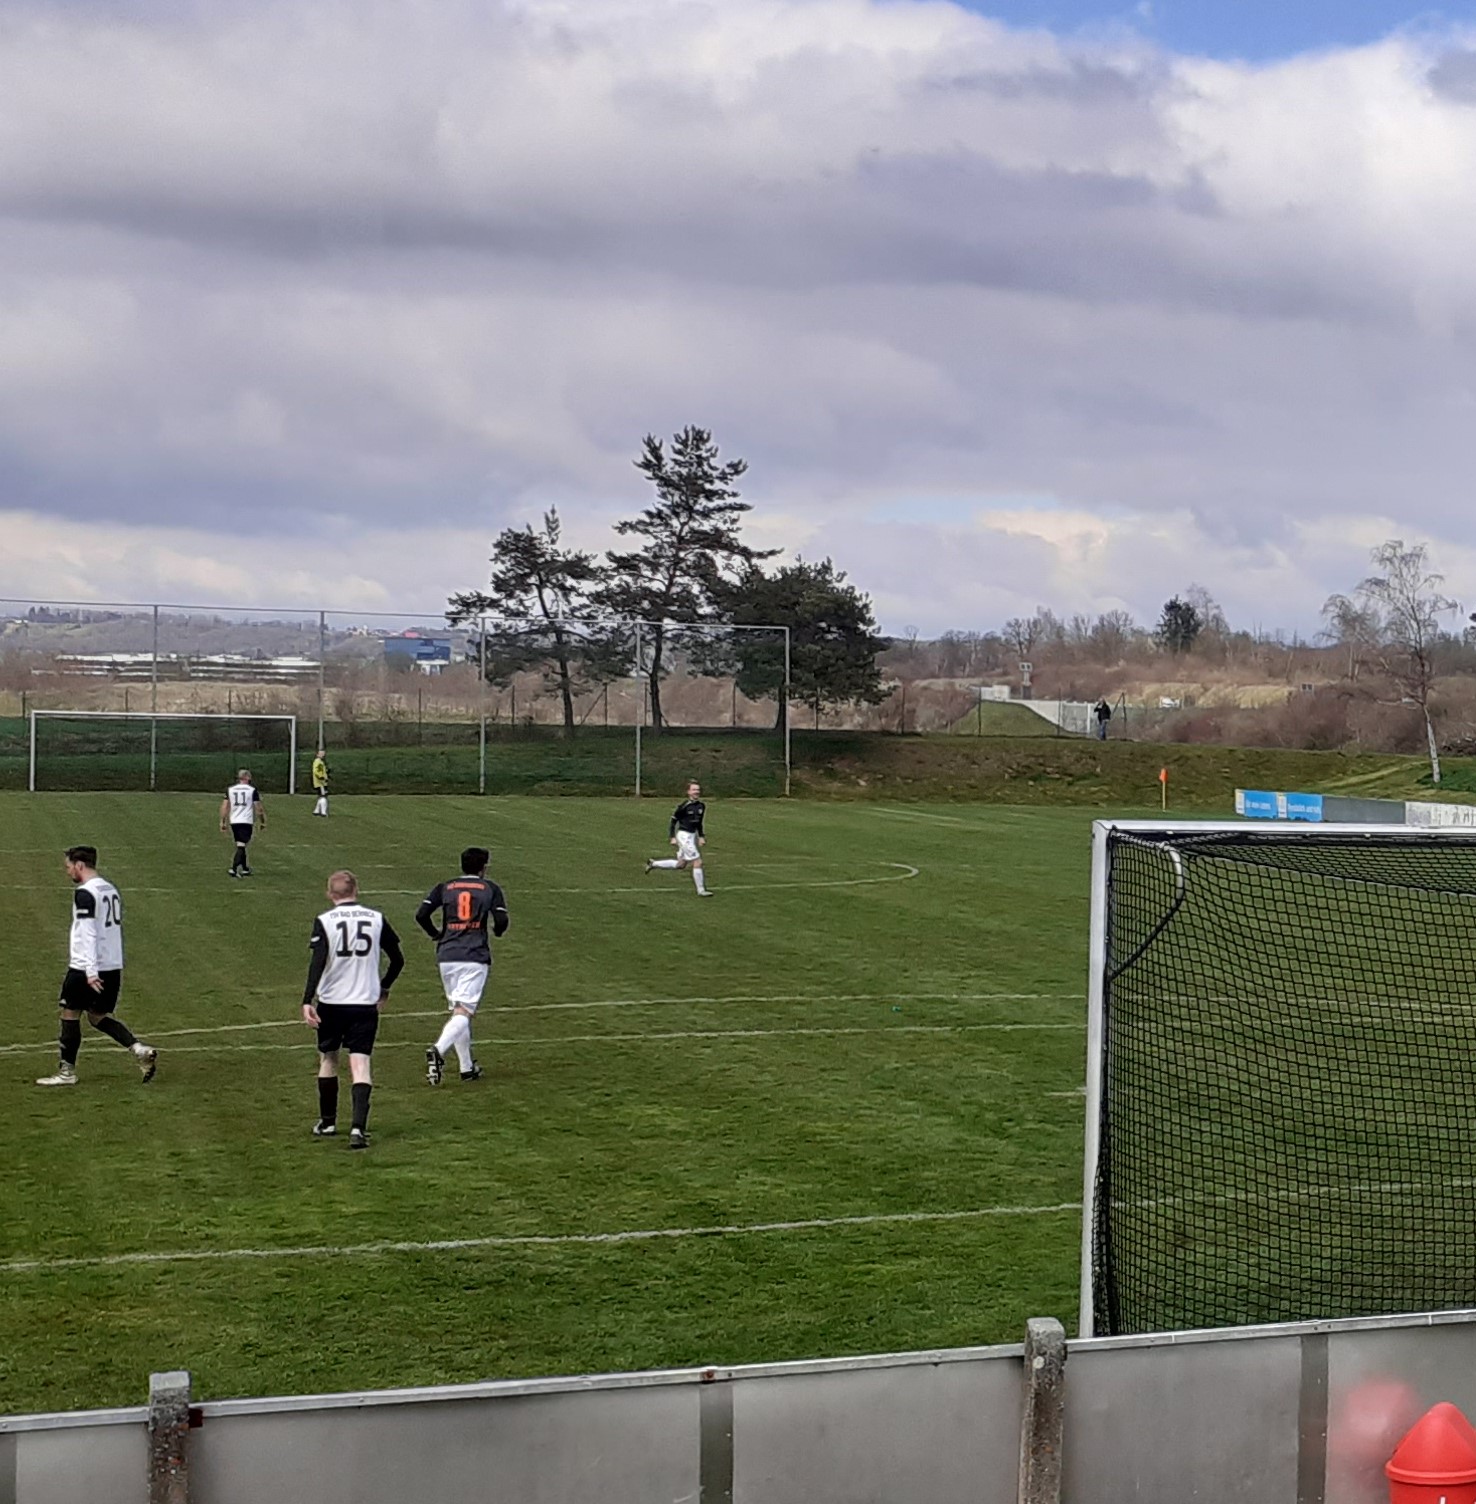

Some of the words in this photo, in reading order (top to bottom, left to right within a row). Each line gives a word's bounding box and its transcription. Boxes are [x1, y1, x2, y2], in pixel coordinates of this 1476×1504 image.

[233, 791, 247, 806] 11
[457, 891, 472, 920] 8
[335, 920, 373, 957] 15
